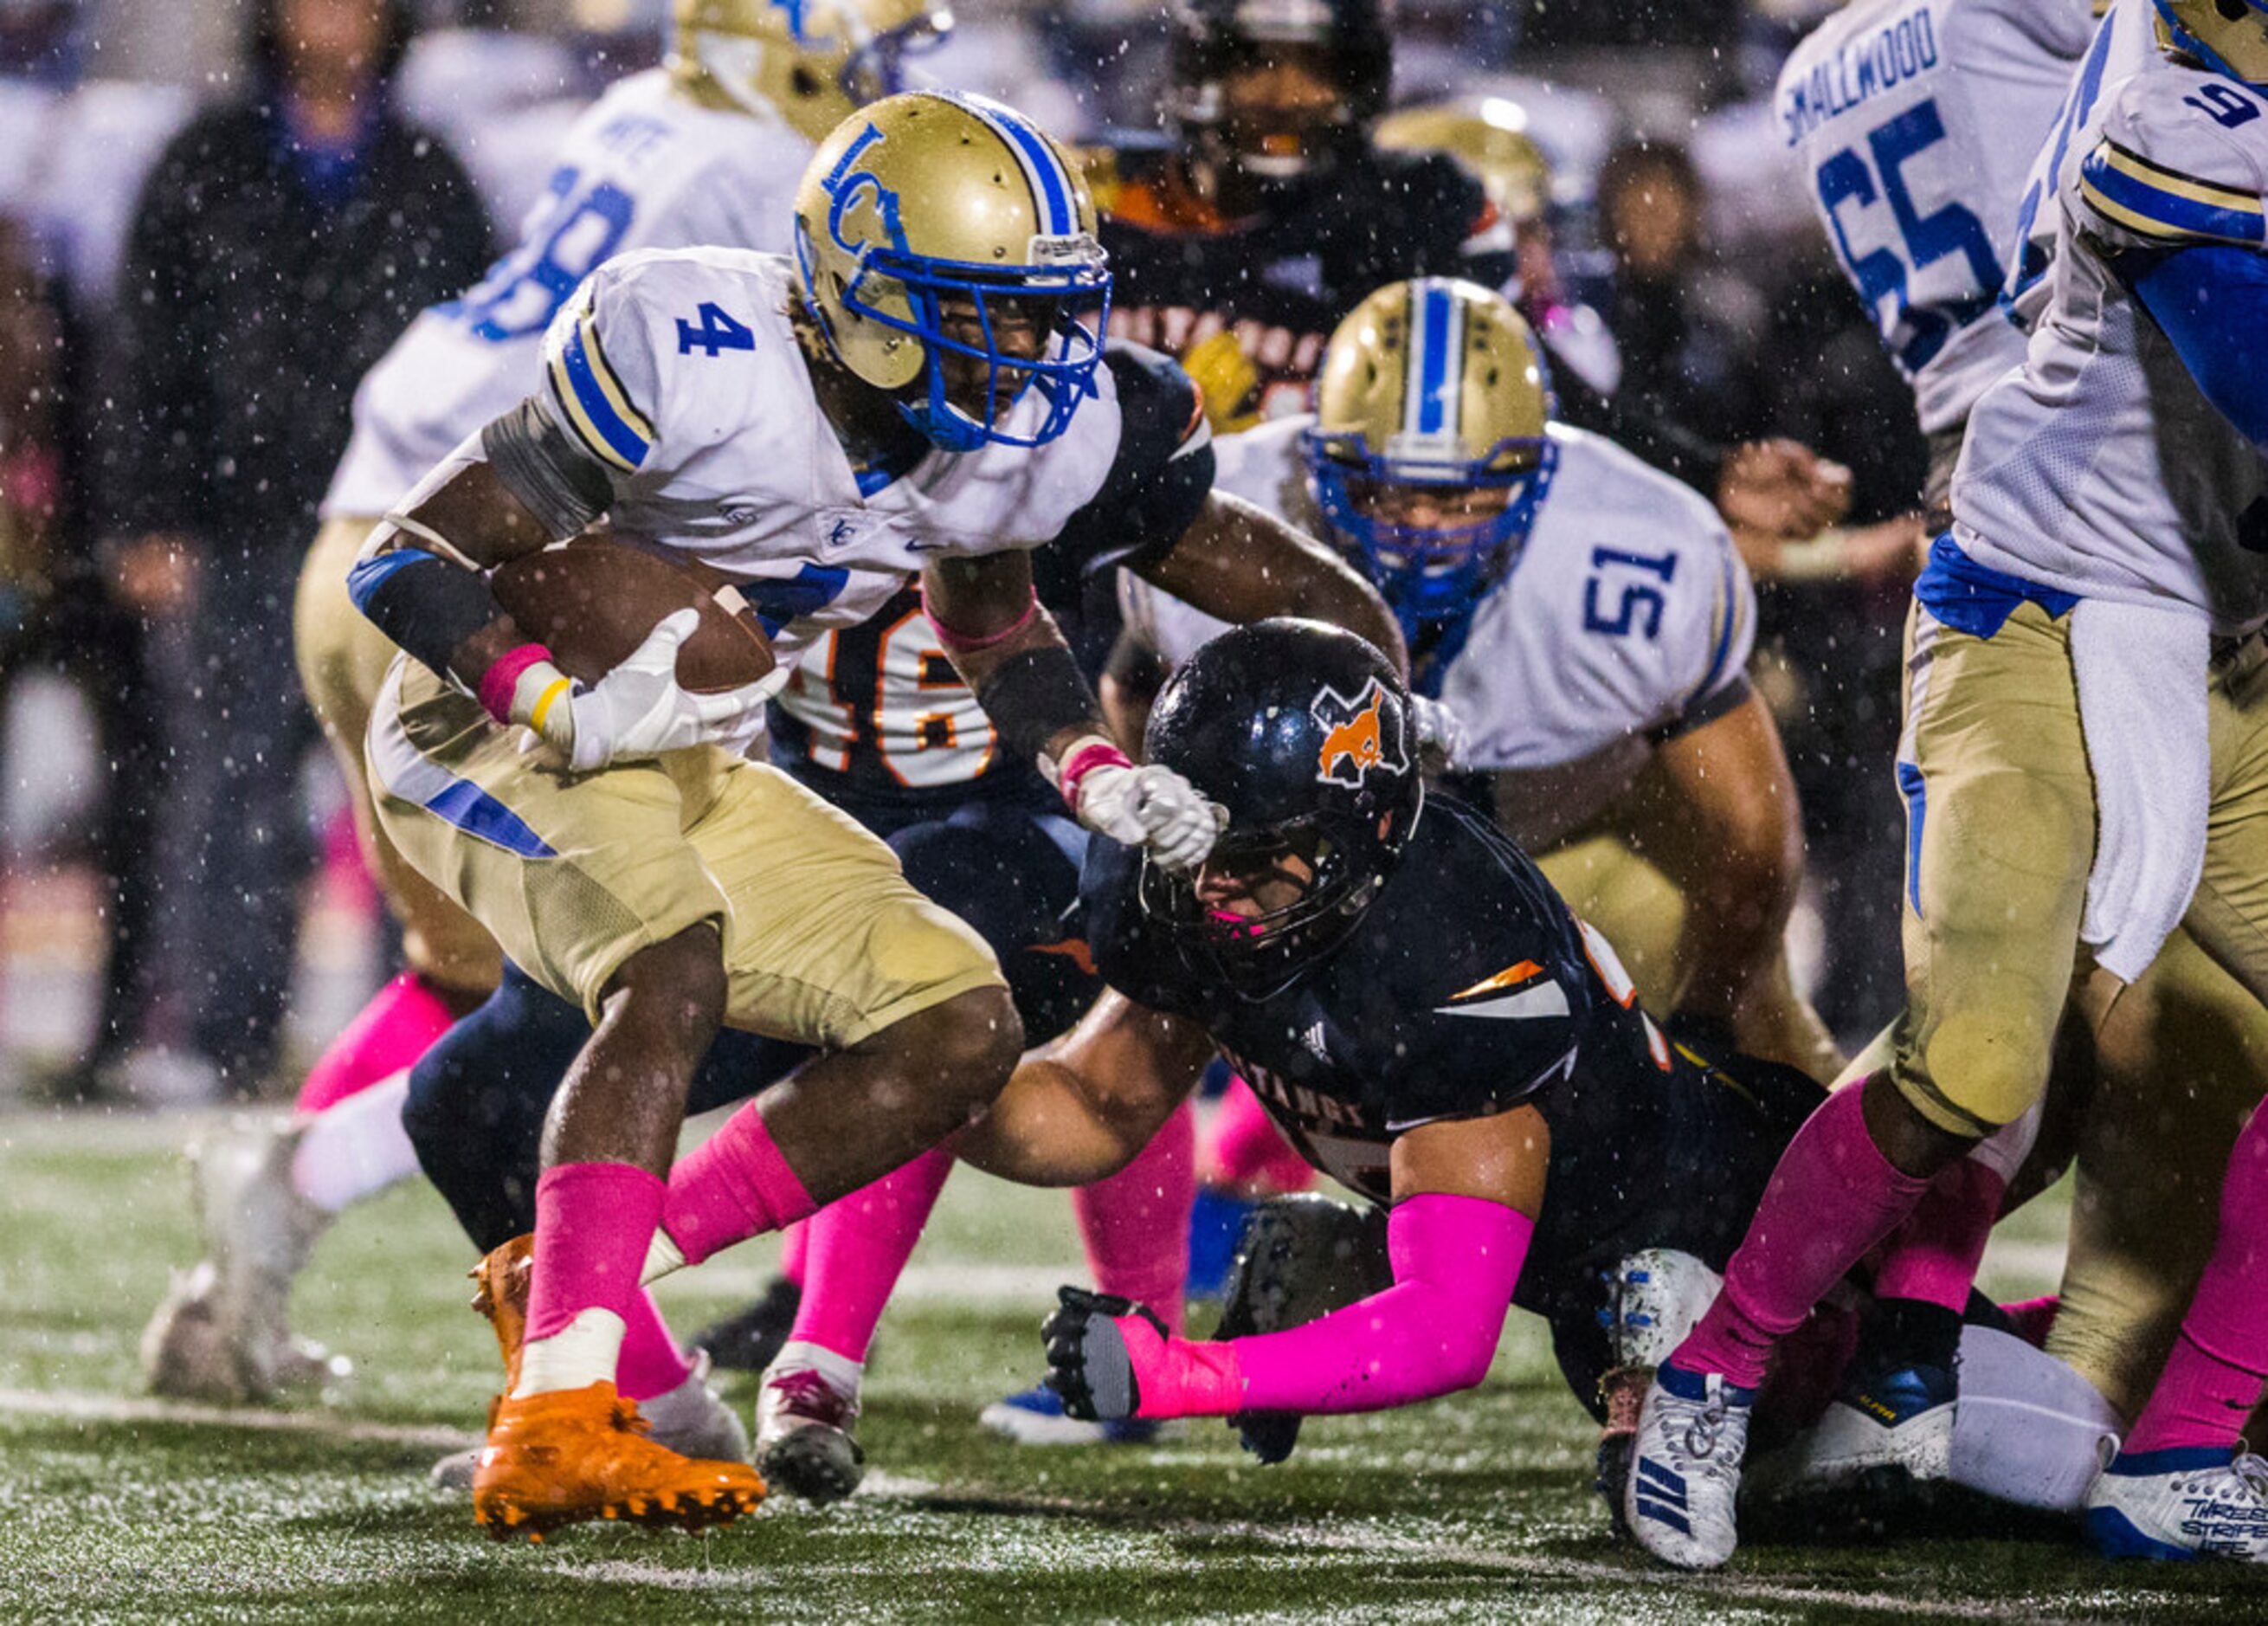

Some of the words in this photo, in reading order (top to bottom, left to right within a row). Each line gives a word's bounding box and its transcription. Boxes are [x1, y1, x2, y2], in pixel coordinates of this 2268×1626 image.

[1816, 96, 2007, 374] 65
[674, 300, 756, 358] 4
[1583, 544, 1678, 641] 51
